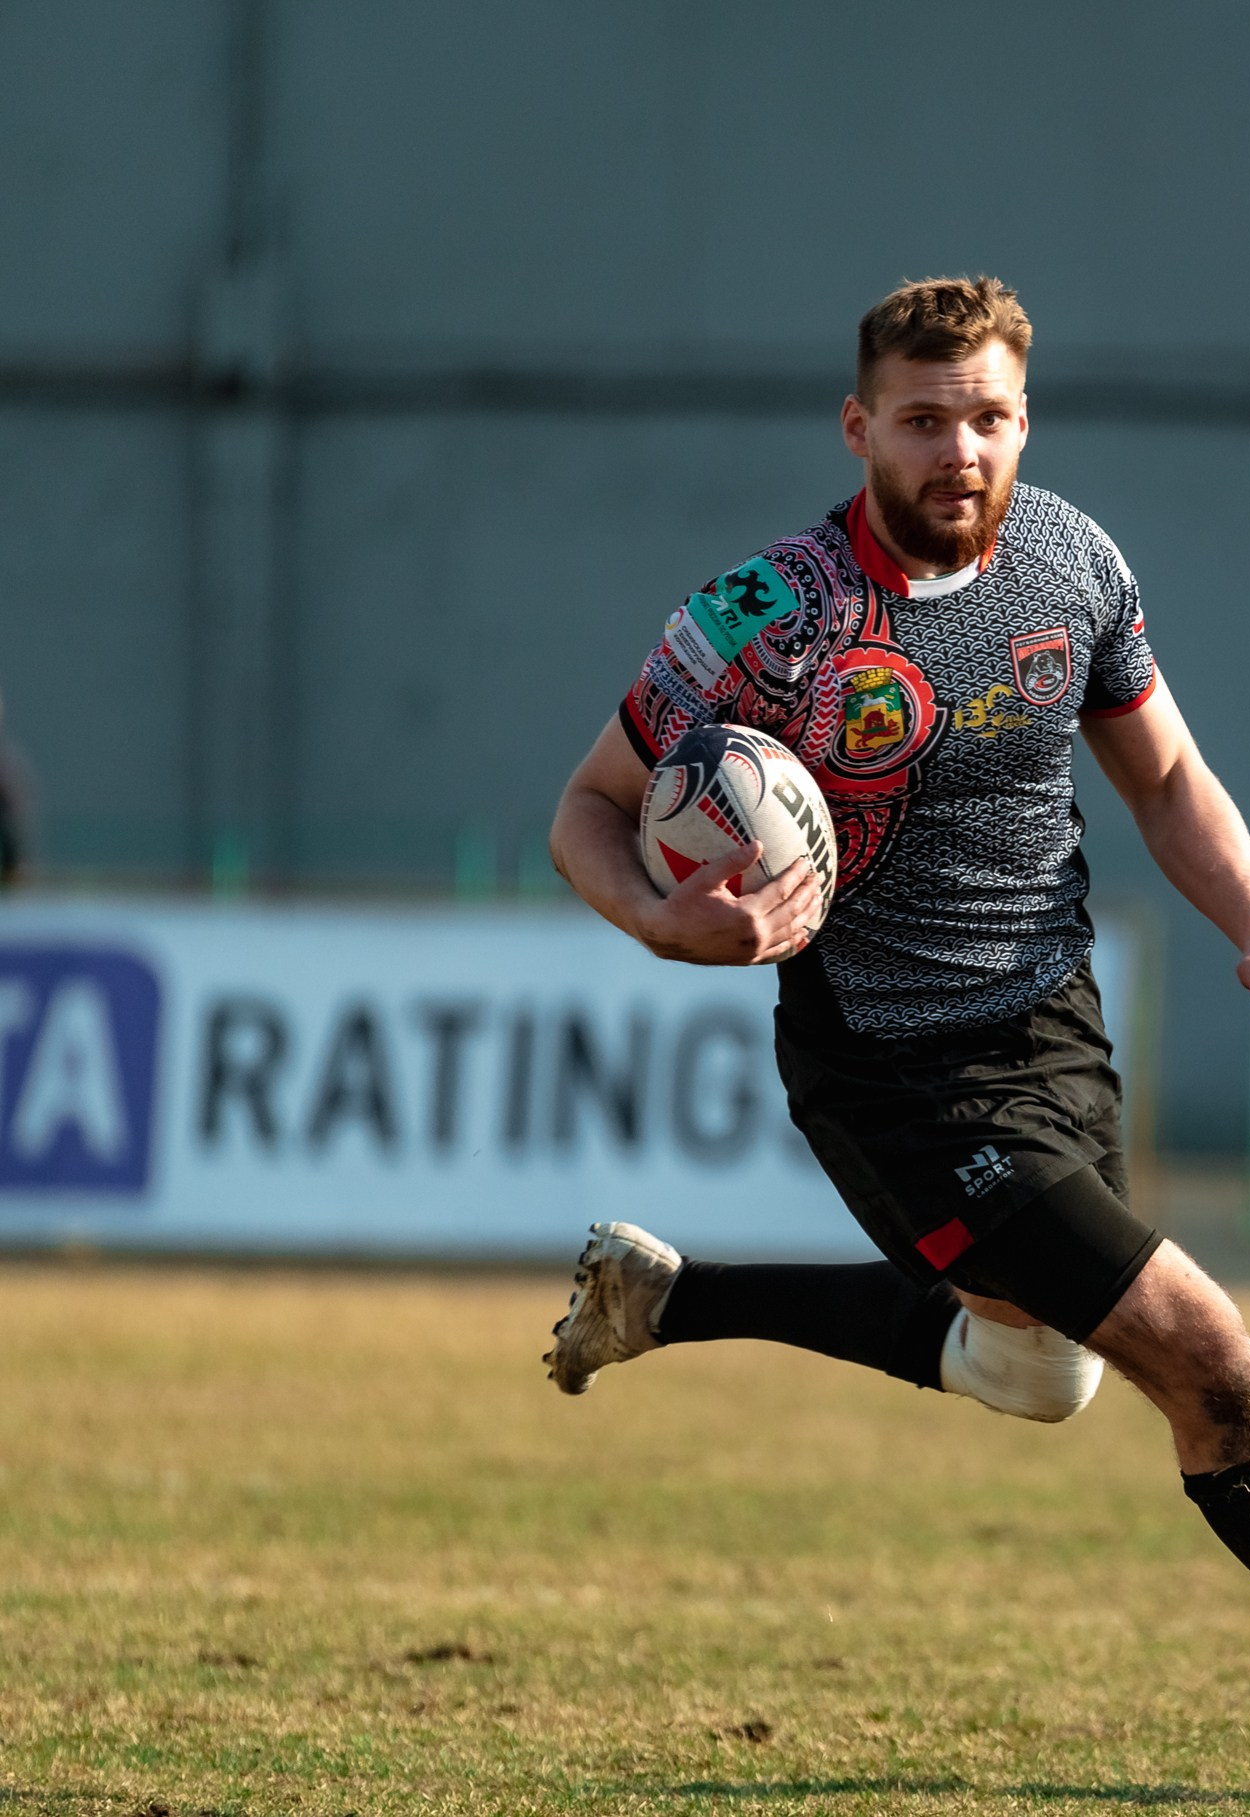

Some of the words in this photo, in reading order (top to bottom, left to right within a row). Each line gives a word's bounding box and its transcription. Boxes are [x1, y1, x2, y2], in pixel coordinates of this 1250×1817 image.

[677, 629, 716, 676] ГЕНЕРИРУЮЩАЯ
[682, 625, 706, 657] СИБИРСКАЯ
[202, 998, 806, 1166] RATING
[965, 1156, 1012, 1197] SPORT
